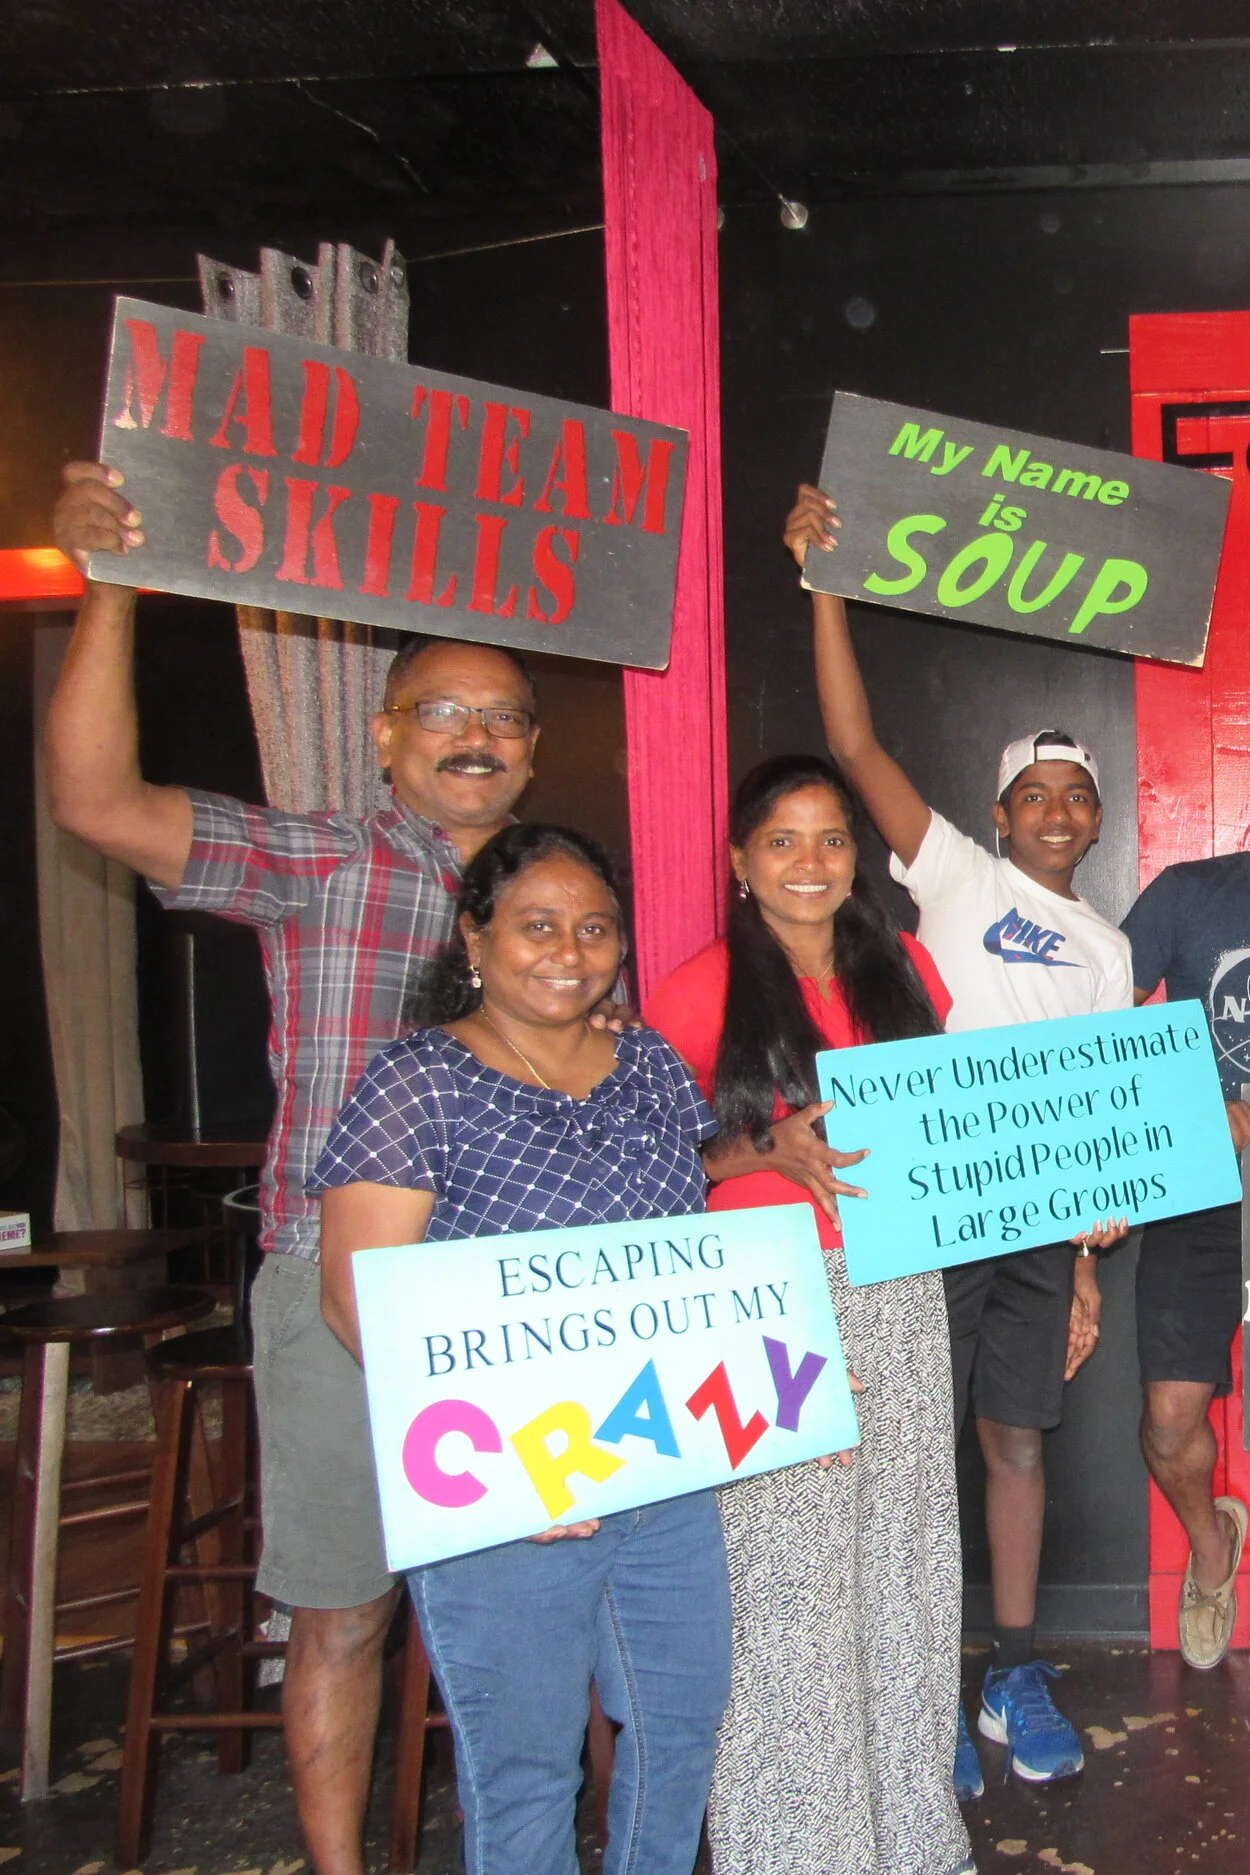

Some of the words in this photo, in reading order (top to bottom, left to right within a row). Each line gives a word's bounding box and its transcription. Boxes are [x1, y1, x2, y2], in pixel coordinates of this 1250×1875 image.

[110, 318, 361, 468] MAD
[411, 385, 675, 534] TEAM
[887, 422, 975, 475] My
[981, 444, 1130, 506] Name
[206, 463, 581, 626] SKILLS
[978, 494, 1028, 532] is
[862, 514, 1149, 634] SOUP
[998, 907, 1067, 961] NIKE
[830, 1065, 943, 1109] Never
[952, 1023, 1201, 1090] Underestimate
[919, 1107, 981, 1145] the
[987, 1089, 1101, 1134] Power
[1110, 1074, 1144, 1112] of
[908, 1148, 1026, 1201] Stupid
[1032, 1125, 1139, 1184] People
[1144, 1121, 1173, 1152] in
[931, 1198, 1040, 1249] Large
[1049, 1172, 1167, 1221] Groups
[496, 1233, 726, 1298] ESCAPING
[424, 1308, 618, 1378] BRINGS
[629, 1293, 718, 1340] OUT
[731, 1281, 791, 1325] MY
[402, 1335, 828, 1522] CRAZY
